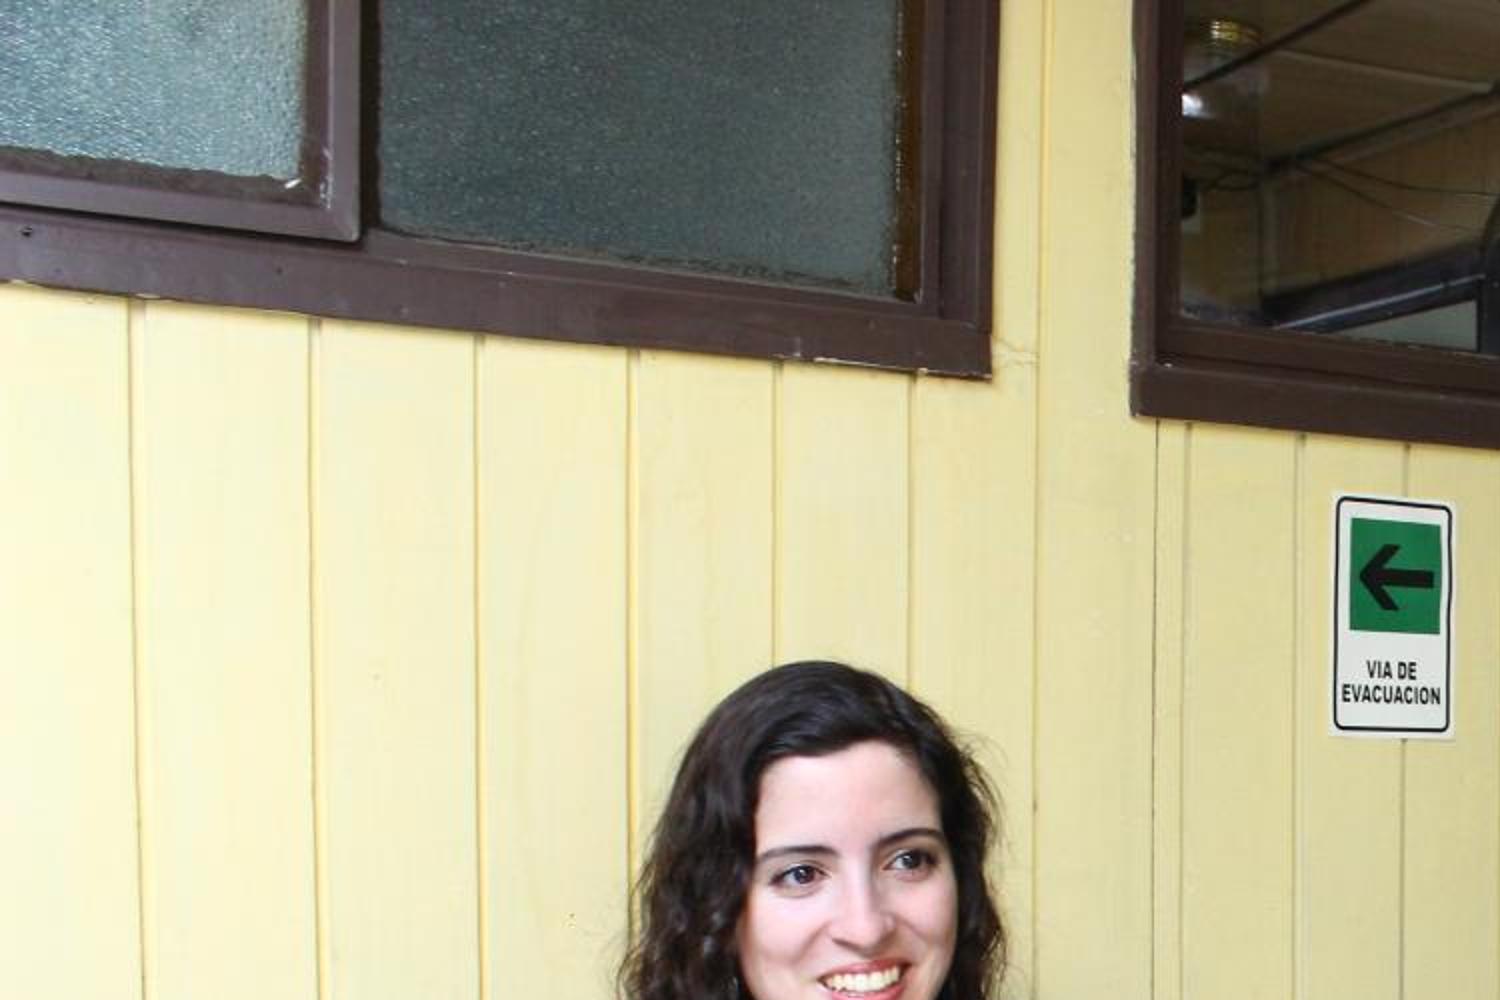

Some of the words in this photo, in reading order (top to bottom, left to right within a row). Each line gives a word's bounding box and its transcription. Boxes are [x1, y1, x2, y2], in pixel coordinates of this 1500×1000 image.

[1366, 660, 1393, 679] VIA
[1397, 661, 1417, 681] DE
[1341, 683, 1441, 705] EVACUACION
